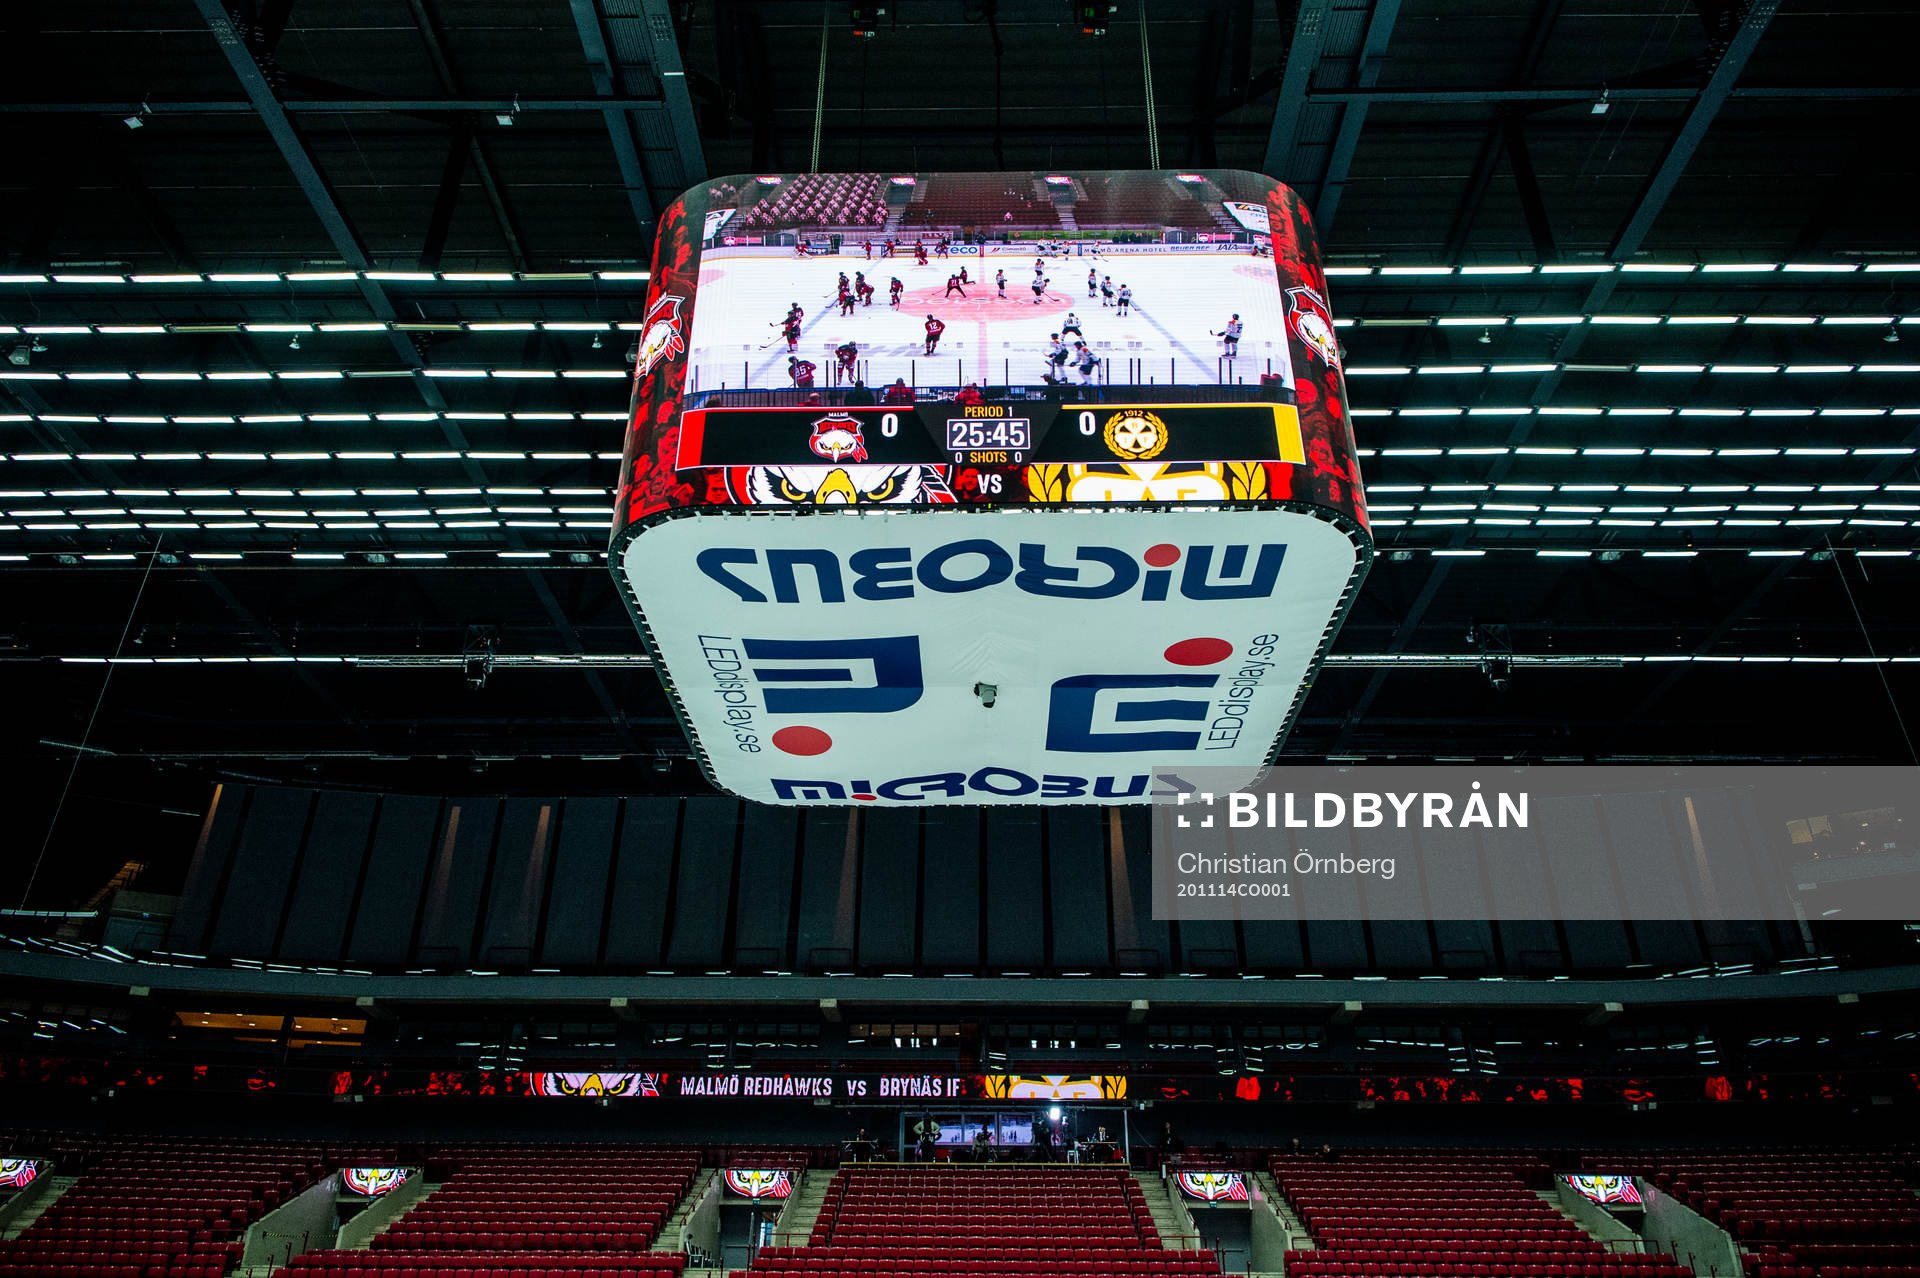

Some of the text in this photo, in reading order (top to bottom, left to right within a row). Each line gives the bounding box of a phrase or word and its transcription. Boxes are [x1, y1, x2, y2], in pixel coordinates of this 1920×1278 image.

[964, 406, 1013, 417] PERIOD 1
[1078, 411, 1096, 436] 0
[881, 413, 899, 437] 0
[952, 422, 1025, 447] 25:45
[955, 451, 1022, 463] 0 SHOTS 0
[977, 474, 1002, 494] VS
[697, 634, 761, 753] LEDdisplay.se
[1204, 634, 1279, 750] LEDdisplay.se
[680, 1074, 739, 1096] MALMÖ
[744, 1077, 833, 1096] REDHAWKS
[879, 1075, 942, 1096] BRYNÄS
[946, 1078, 961, 1096] IF
